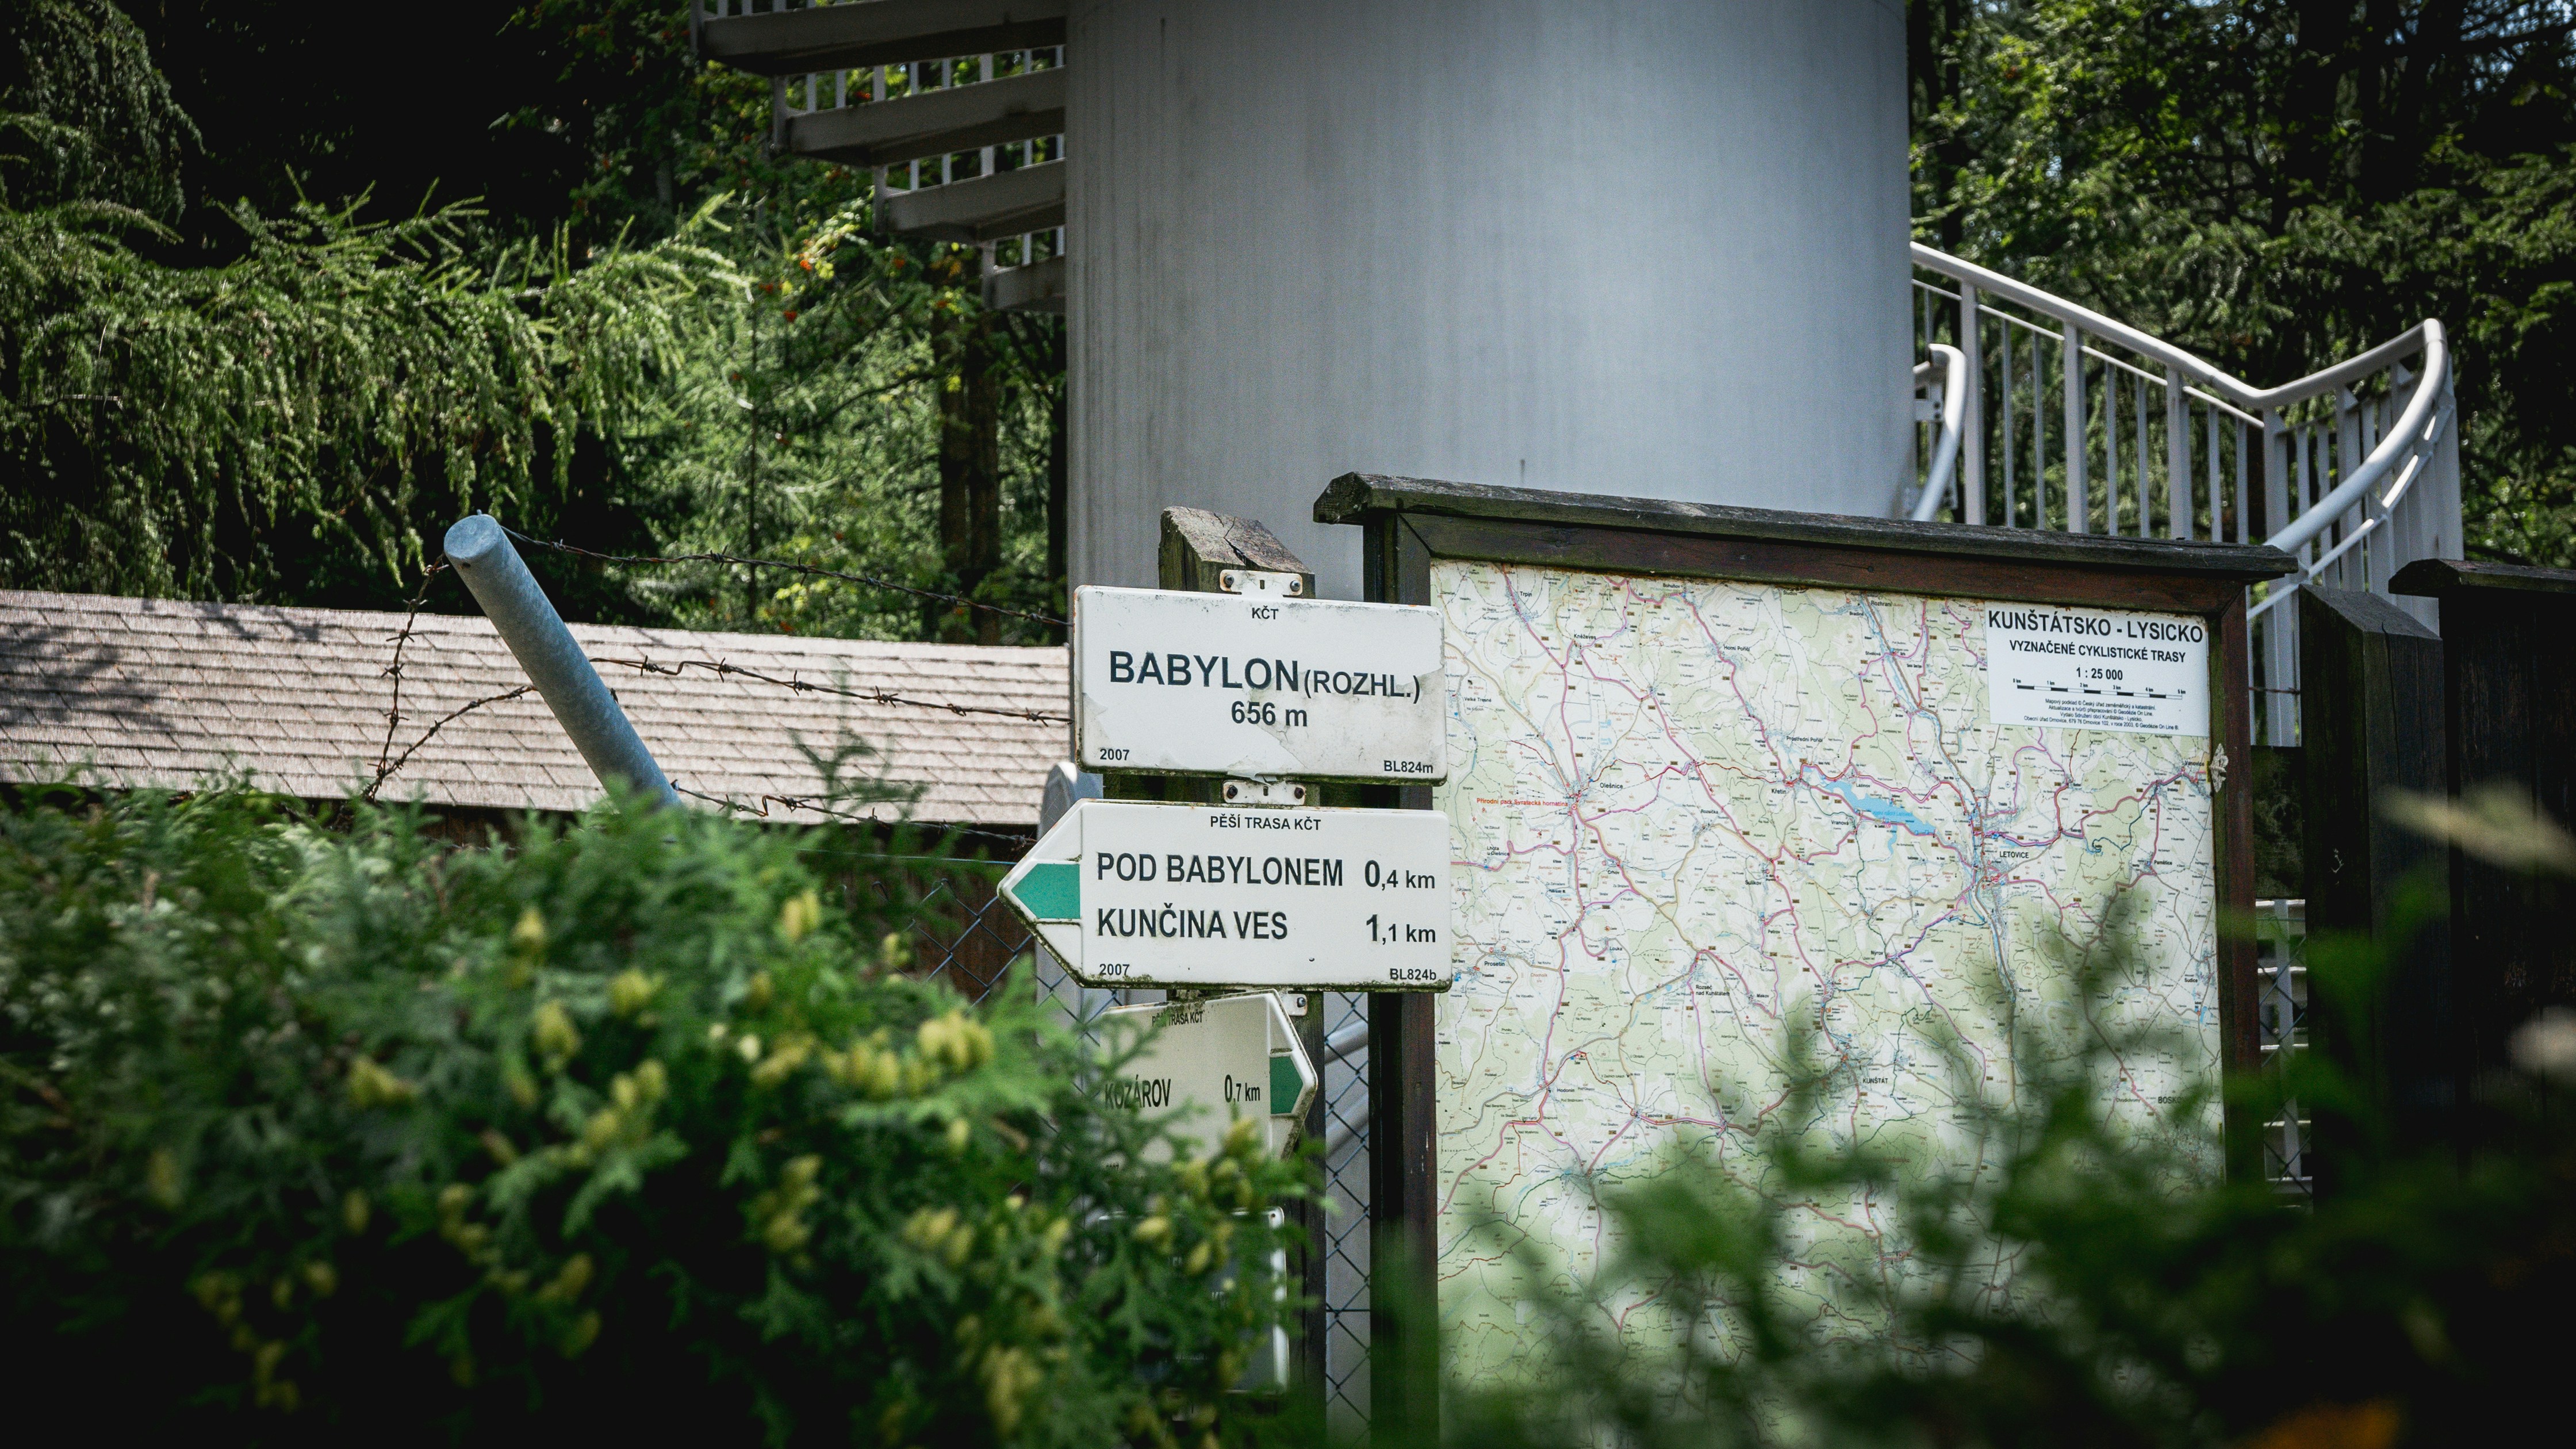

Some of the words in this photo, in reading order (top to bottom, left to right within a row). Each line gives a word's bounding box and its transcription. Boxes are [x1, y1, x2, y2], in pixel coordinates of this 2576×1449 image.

[1251, 606, 1279, 620] KČT
[1989, 609, 2111, 636] KUNŠTÁTSKO
[2128, 621, 2203, 643] LYSICKO
[2010, 640, 2075, 655] VYZNAČENÉ
[2079, 645, 2148, 660] CYKLISTICKÉ
[2151, 650, 2186, 662] TRASY
[1110, 650, 1298, 691] BABYLON
[1304, 669, 1420, 704] (ROZHL.)
[2076, 667, 2081, 677] 1
[2091, 668, 2103, 679] 25
[2106, 669, 2123, 680] 000
[1231, 701, 1276, 726] 656
[1285, 707, 1308, 726] m
[1100, 748, 1129, 761] 2007
[1383, 760, 1433, 774] BL824m
[1210, 814, 1241, 829] PĚŠÍ
[1245, 817, 1291, 830] TRASA
[1293, 816, 1321, 831] KČT
[1097, 852, 1156, 881] POD
[1166, 855, 1343, 887] BABYLONEM
[1364, 860, 1399, 891] 0,4
[1405, 870, 1436, 889] km
[1097, 903, 1227, 939] KUNČINA
[1233, 910, 1288, 940] VES
[1366, 914, 1397, 944] 1,1
[1405, 924, 1436, 944] km
[1099, 963, 1130, 977] 2007
[1389, 967, 1438, 982] BL824b
[1190, 1009, 1203, 1023] KČT
[1105, 1074, 1171, 1109] KOZÁROV
[1224, 1074, 1242, 1103] 0,7
[1244, 1083, 1260, 1102] km
